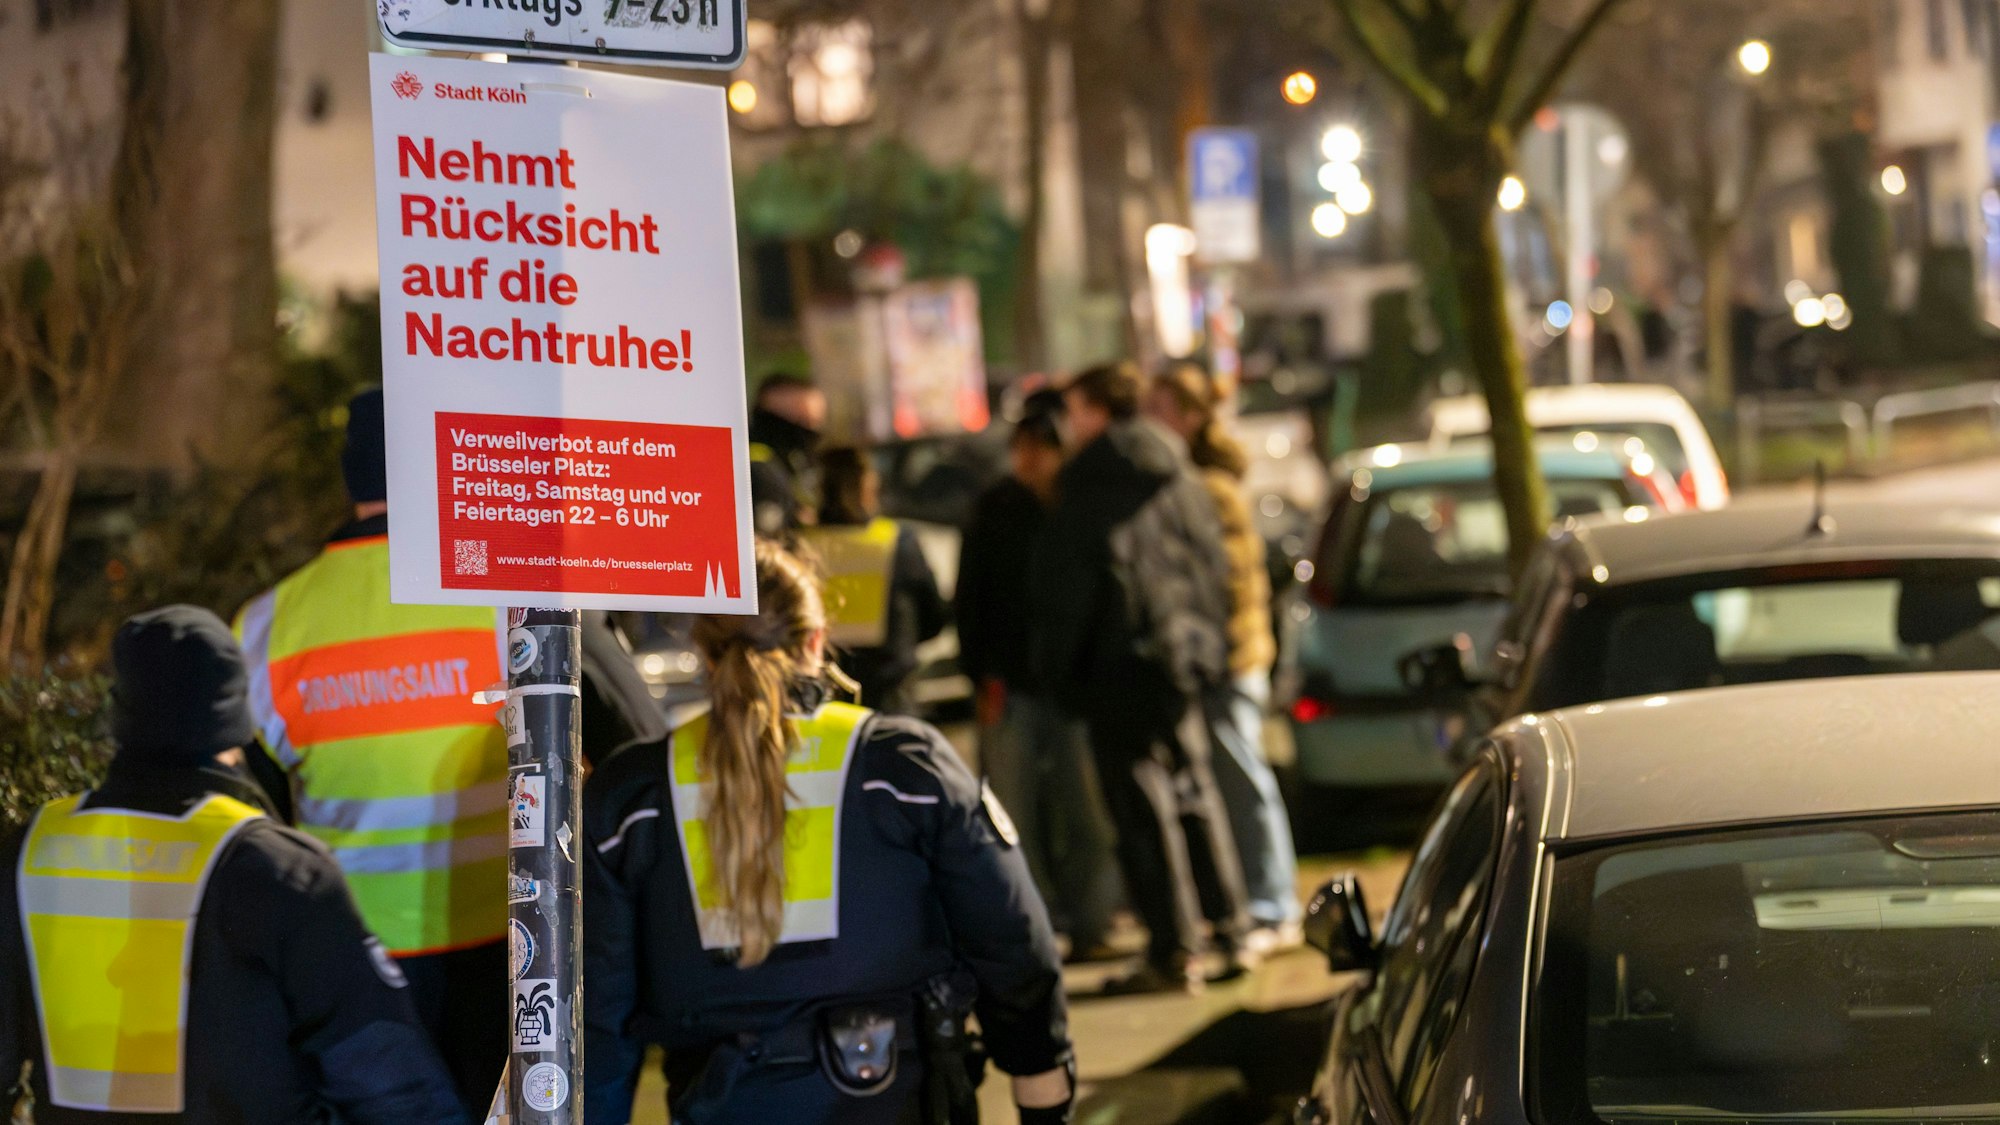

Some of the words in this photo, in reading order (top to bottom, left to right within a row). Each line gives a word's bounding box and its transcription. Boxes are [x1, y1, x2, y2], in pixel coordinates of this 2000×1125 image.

[434, 83, 483, 102] Stadt
[488, 85, 527, 104] Köln
[397, 135, 576, 190] Nehmt
[400, 193, 660, 254] Rücksicht
[402, 257, 489, 300] auf
[498, 258, 578, 305] die
[405, 311, 694, 373] Nachtruhe!
[450, 428, 593, 454] Verweilverbot
[597, 435, 630, 455] auf
[632, 437, 677, 458] dem
[451, 452, 550, 475] Brüsseler
[555, 457, 611, 478] Platz:
[452, 477, 531, 502] Freitag,
[536, 480, 625, 506] Samstag
[629, 486, 667, 505] und
[670, 490, 702, 506] vor
[453, 502, 565, 527] Feiertagen
[569, 505, 596, 525] 22
[616, 507, 629, 526] 6
[634, 509, 670, 528] Uhr
[496, 555, 694, 573] www.stadt-koeln.de/bruesselerplatz
